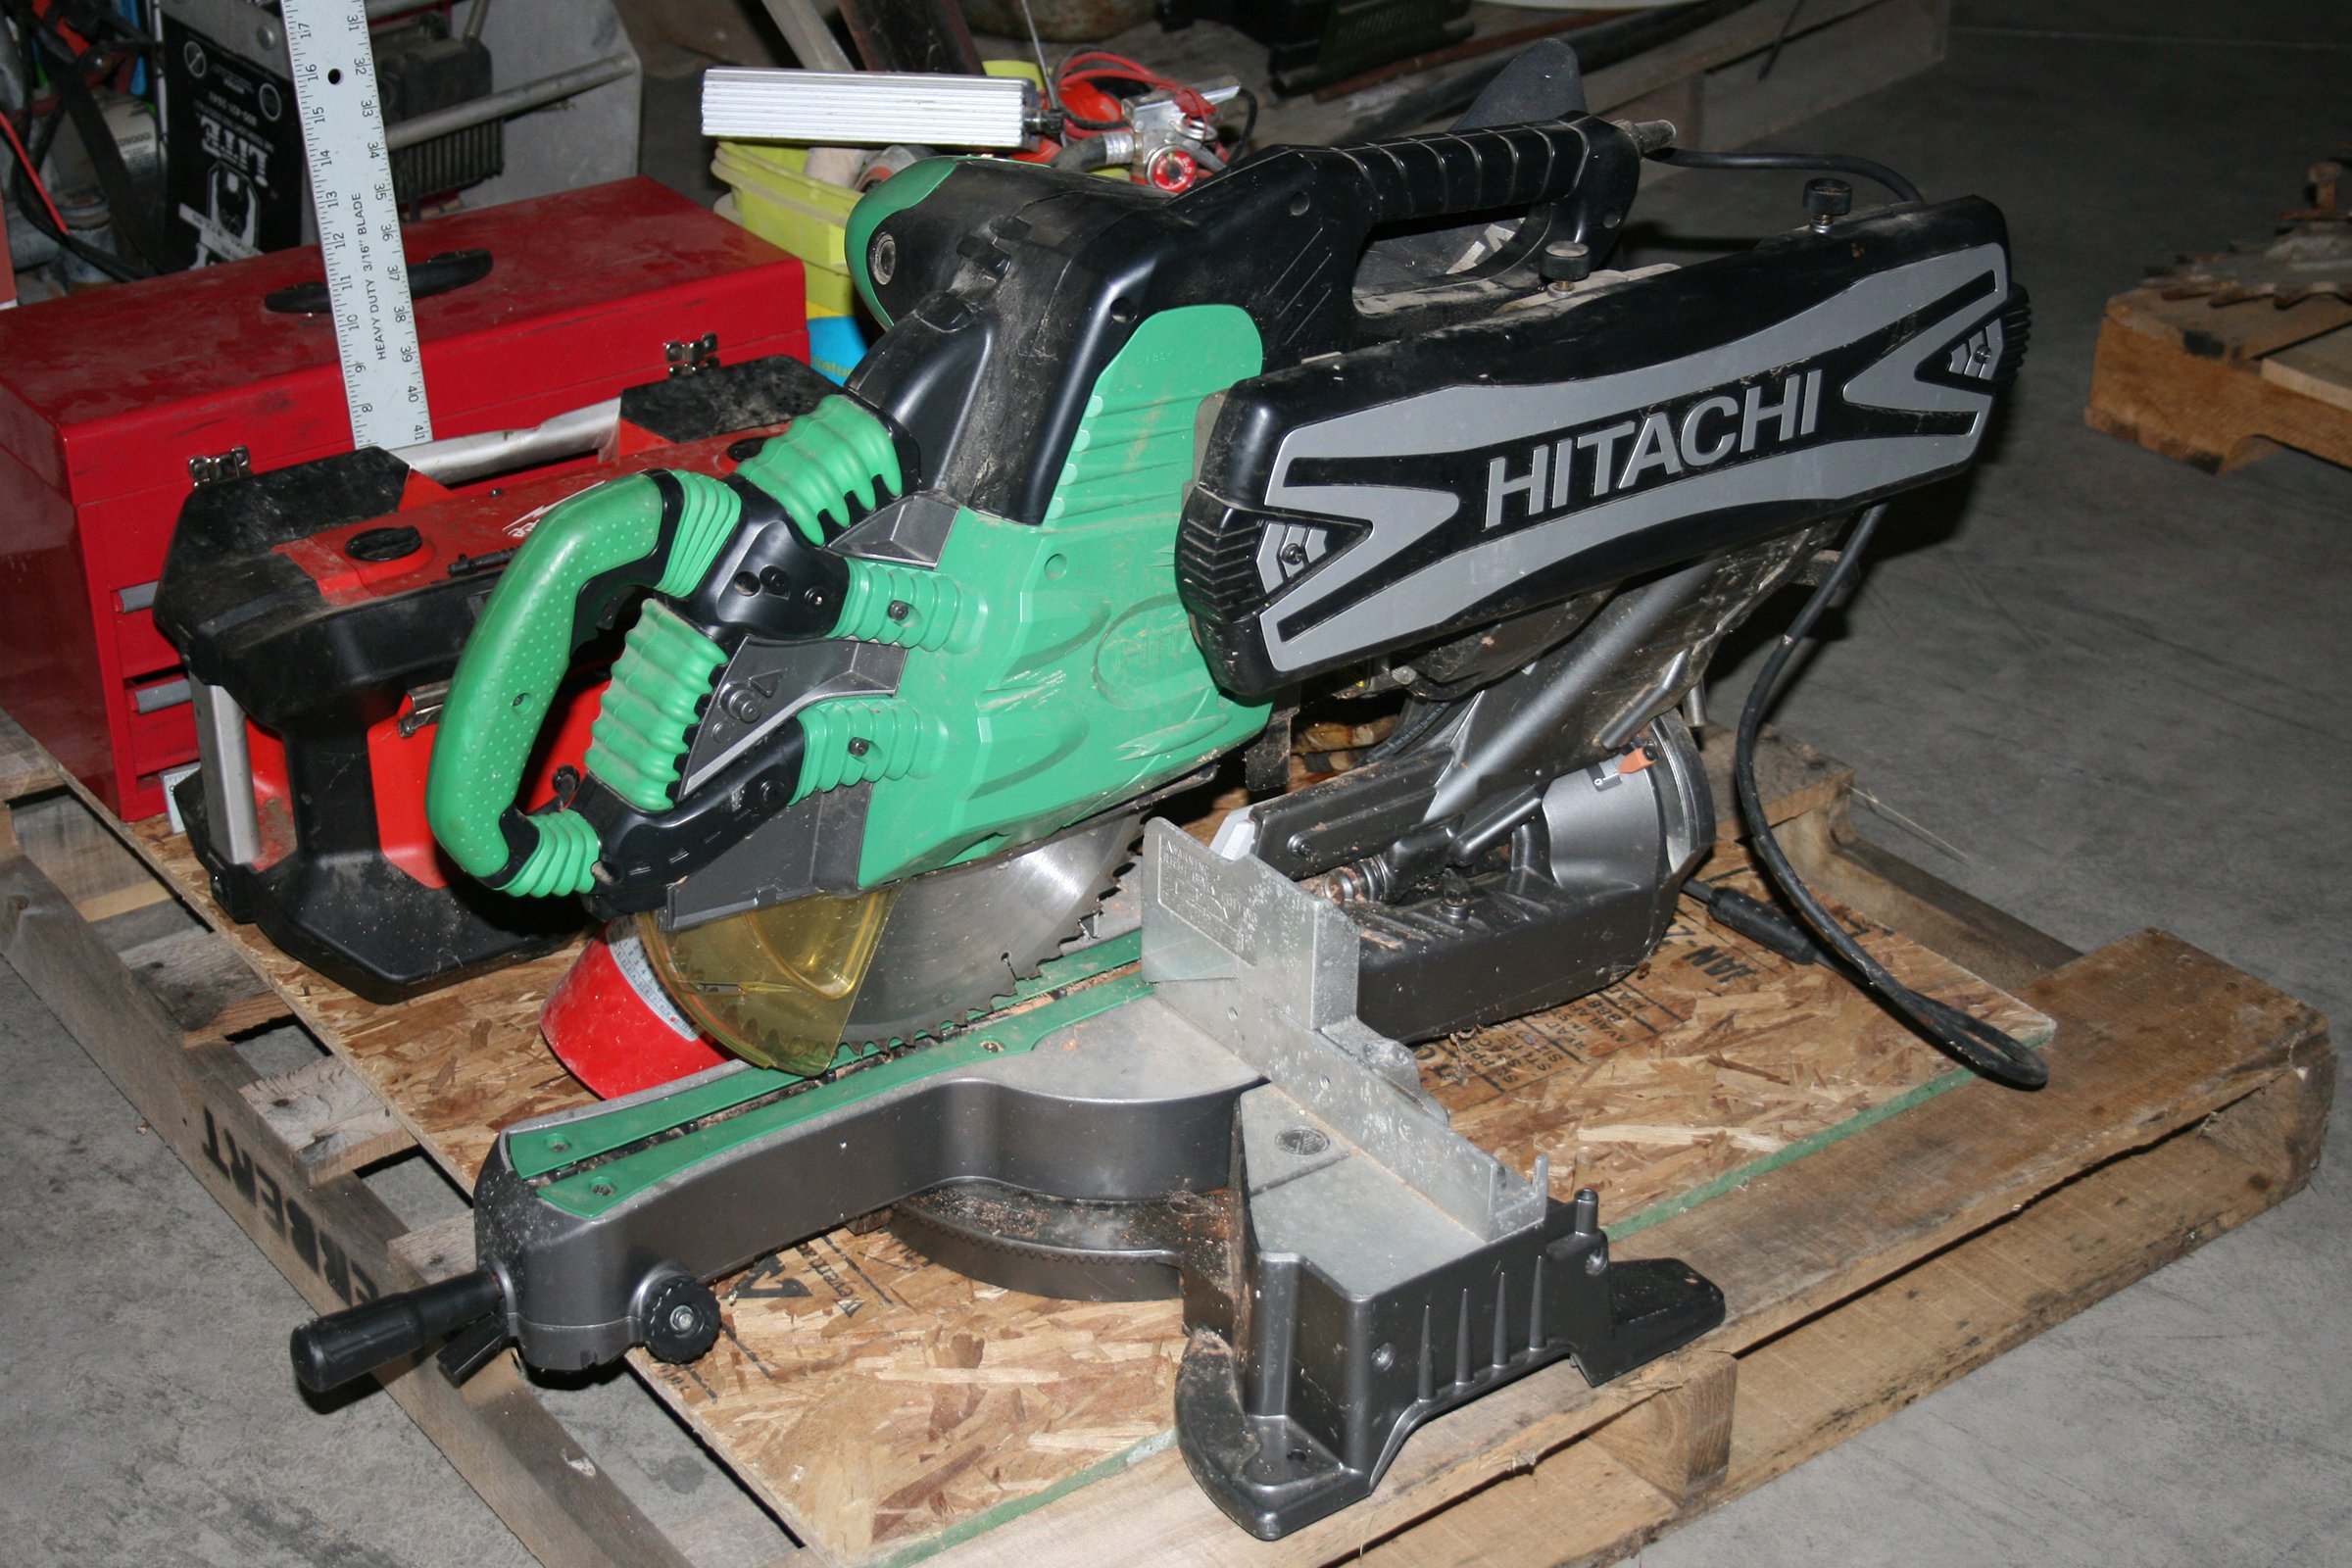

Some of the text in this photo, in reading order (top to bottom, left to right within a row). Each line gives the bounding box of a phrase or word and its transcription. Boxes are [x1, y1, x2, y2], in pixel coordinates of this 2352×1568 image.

[298, 23, 312, 39] 17
[347, 15, 360, 31] 31
[305, 64, 318, 81] 16
[354, 58, 367, 75] 32
[313, 107, 325, 123] 15
[361, 100, 373, 118] 33
[320, 150, 332, 167] 14
[368, 142, 379, 159] 34
[326, 190, 339, 208] 13
[374, 183, 387, 201] 35
[333, 232, 346, 249] 12
[380, 224, 394, 242] 36
[340, 274, 353, 291] 11
[351, 193, 387, 361] HEAVY DUTY 3/16" BLADE
[387, 266, 400, 282] 37
[347, 314, 360, 330] 10
[394, 306, 407, 323] 38
[400, 346, 413, 363] 39
[408, 385, 419, 403] 40
[414, 424, 425, 441] 41
[1484, 368, 1823, 531] HITACHI
